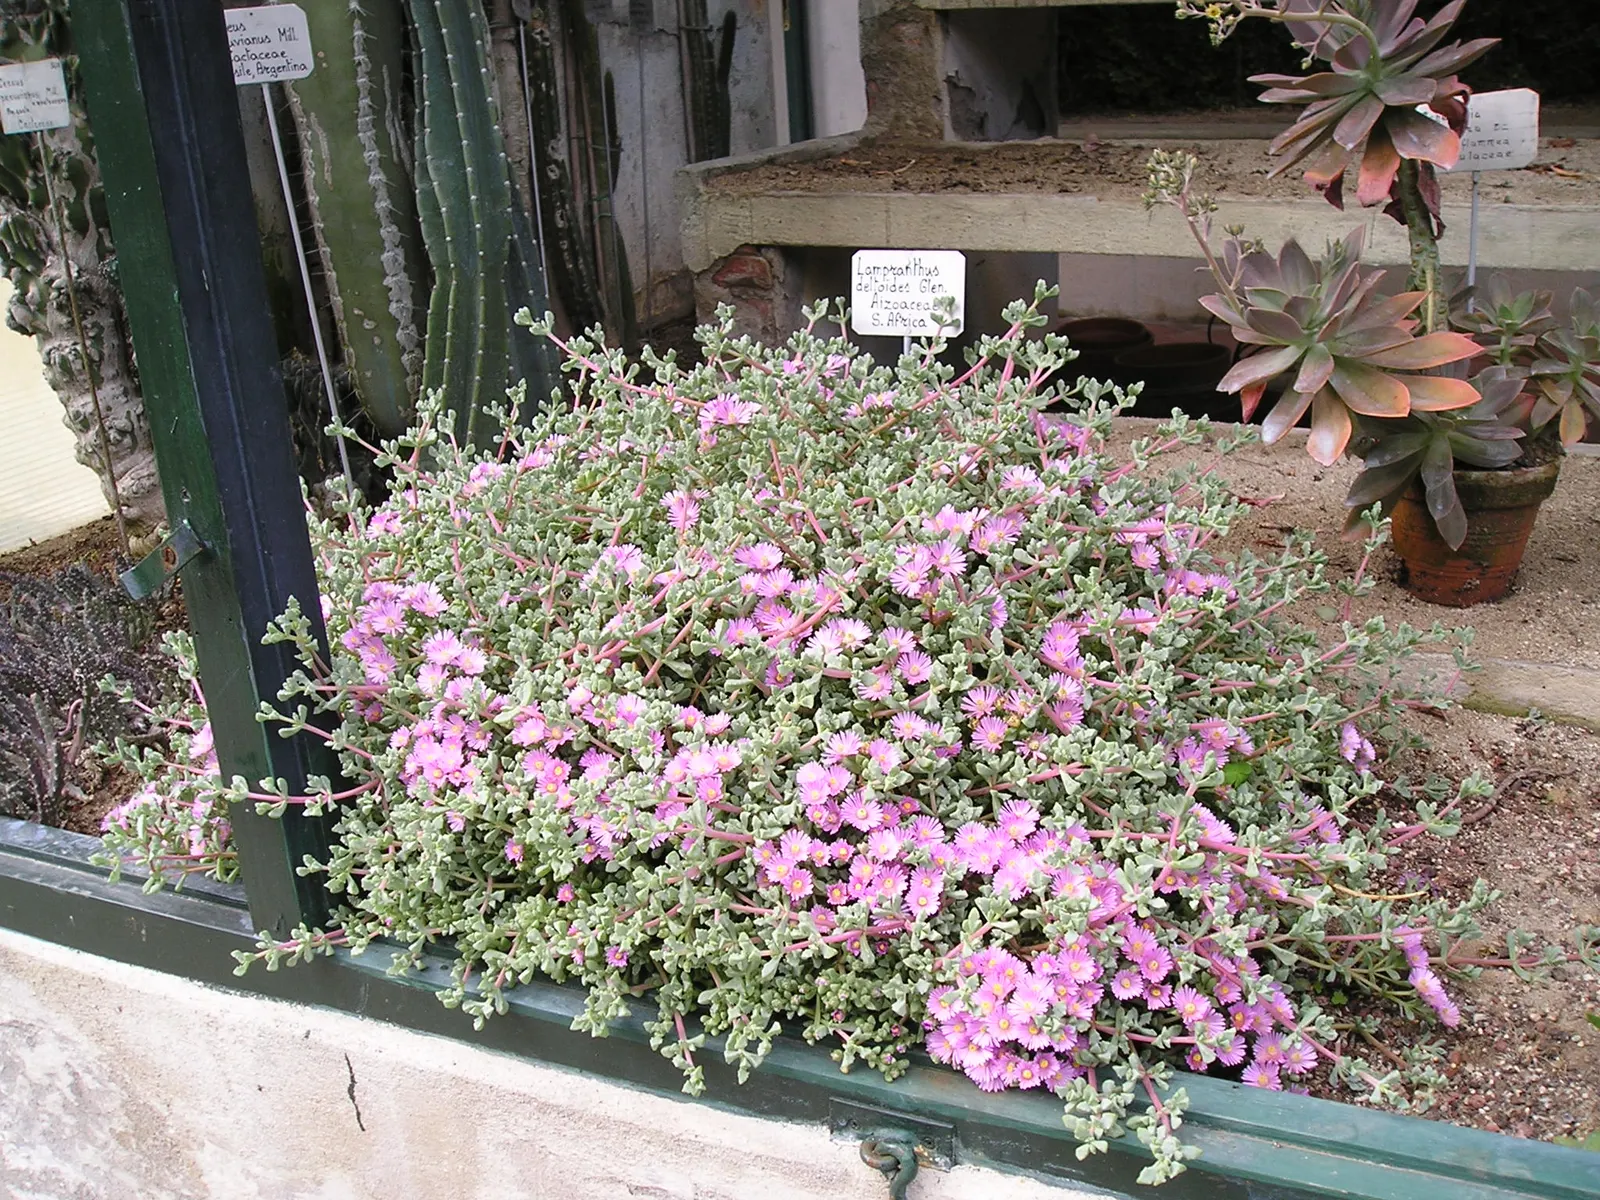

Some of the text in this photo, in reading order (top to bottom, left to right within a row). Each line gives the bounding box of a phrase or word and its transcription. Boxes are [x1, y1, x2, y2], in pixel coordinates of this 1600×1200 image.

[227, 23, 246, 33] eus
[229, 34, 271, 47] uvianus
[231, 48, 288, 62] actaceae
[234, 58, 308, 79] sile, Argentina
[1460, 150, 1512, 160] ulaceae
[857, 256, 940, 281] Lampranthus
[856, 276, 948, 293] deltoides Glen.
[871, 312, 928, 328] S. Africa
